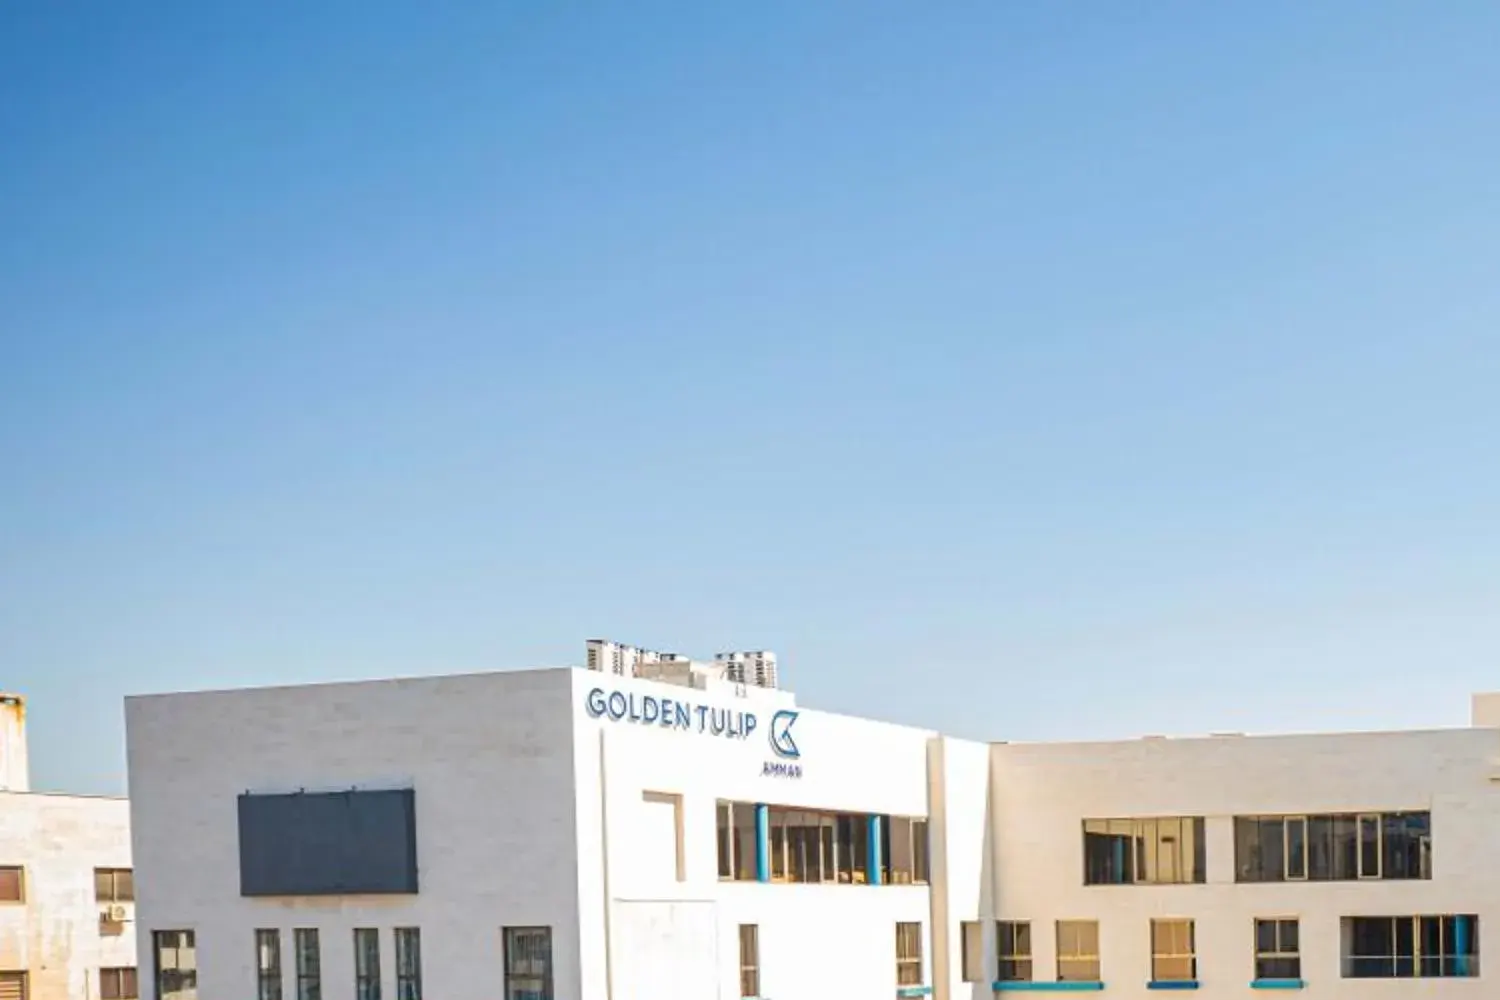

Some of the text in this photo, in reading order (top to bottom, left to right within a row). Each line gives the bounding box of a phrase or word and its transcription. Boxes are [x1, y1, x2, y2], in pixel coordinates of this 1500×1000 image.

[586, 687, 757, 738] GOLDEN TULIP
[762, 760, 802, 778] AMMAN
